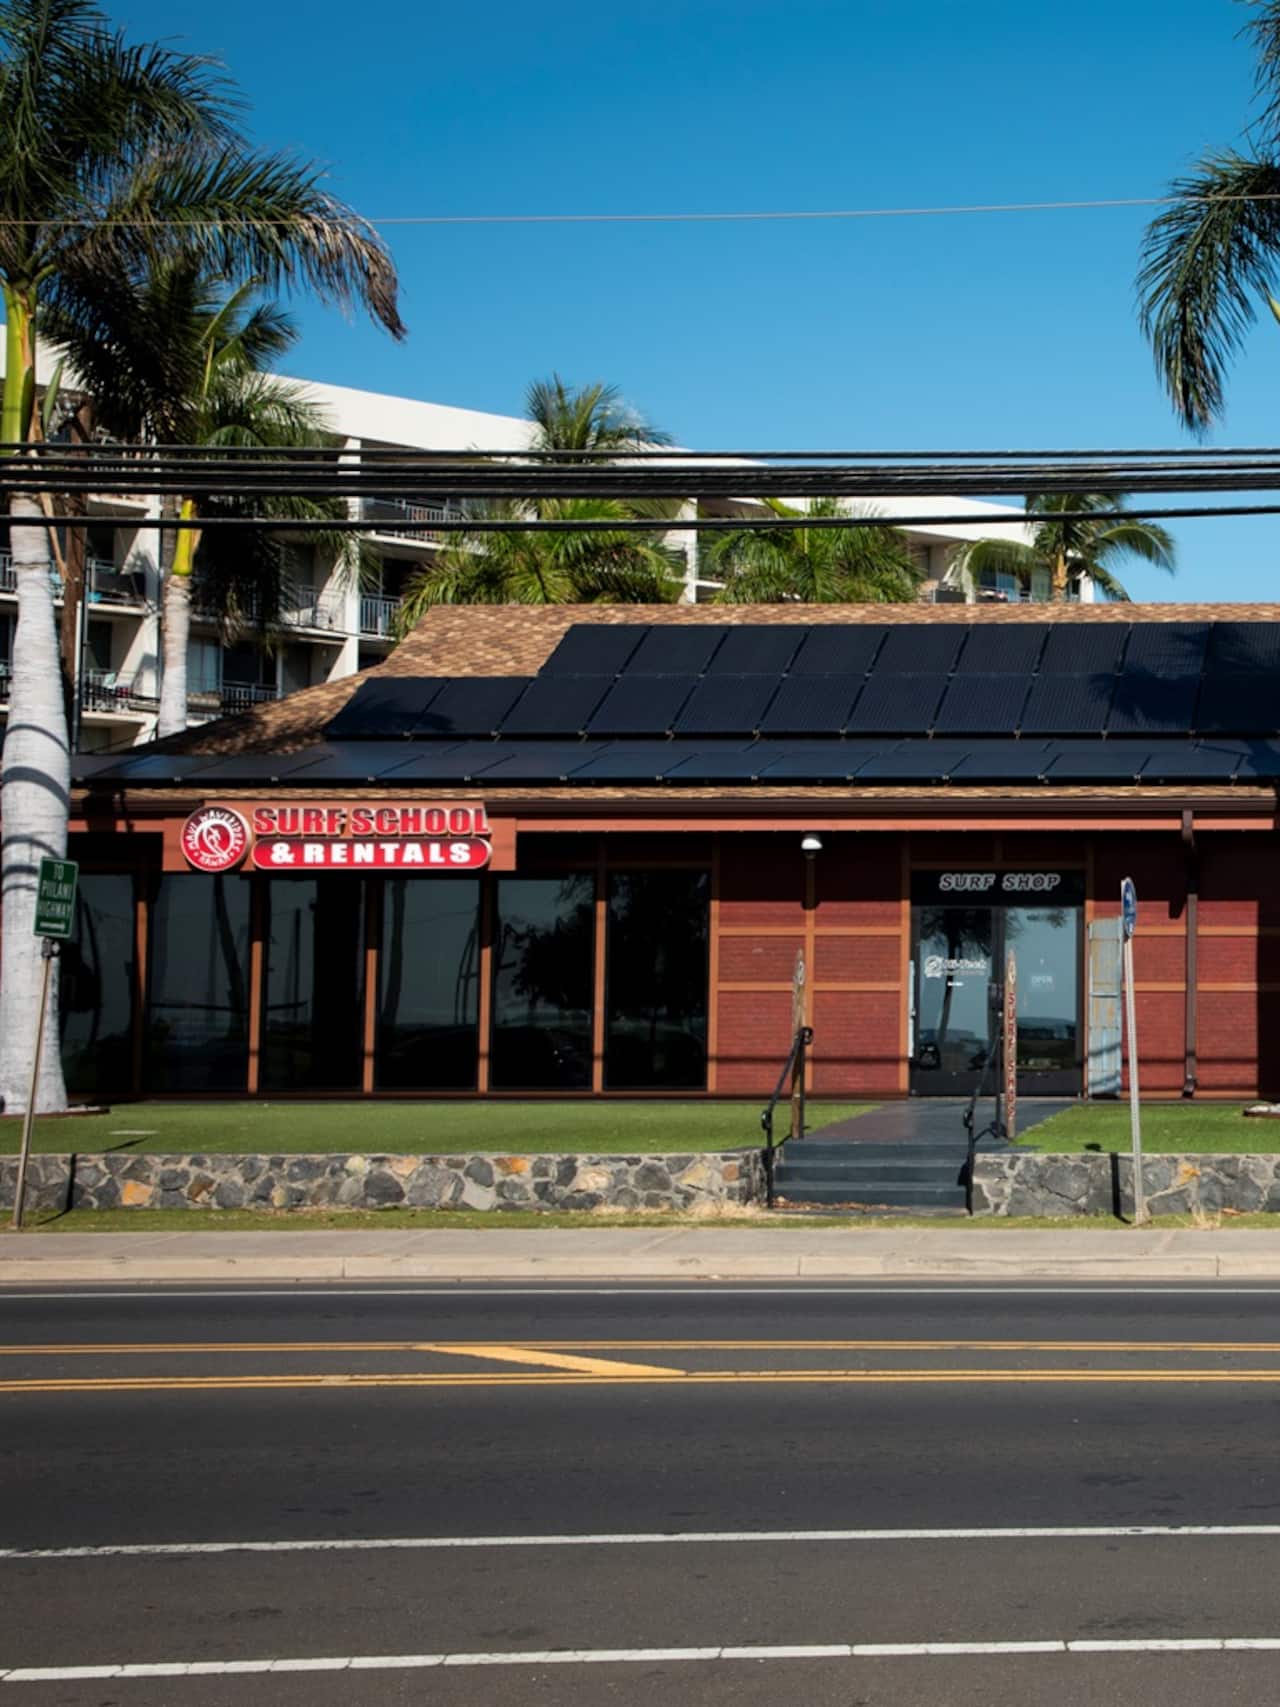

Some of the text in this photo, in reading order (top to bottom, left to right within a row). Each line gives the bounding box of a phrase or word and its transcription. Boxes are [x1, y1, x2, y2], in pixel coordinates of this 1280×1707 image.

[254, 808, 490, 836] SURF SCHOOL
[270, 843, 471, 864] & RENTALS
[939, 873, 1061, 891] SURF SHOP
